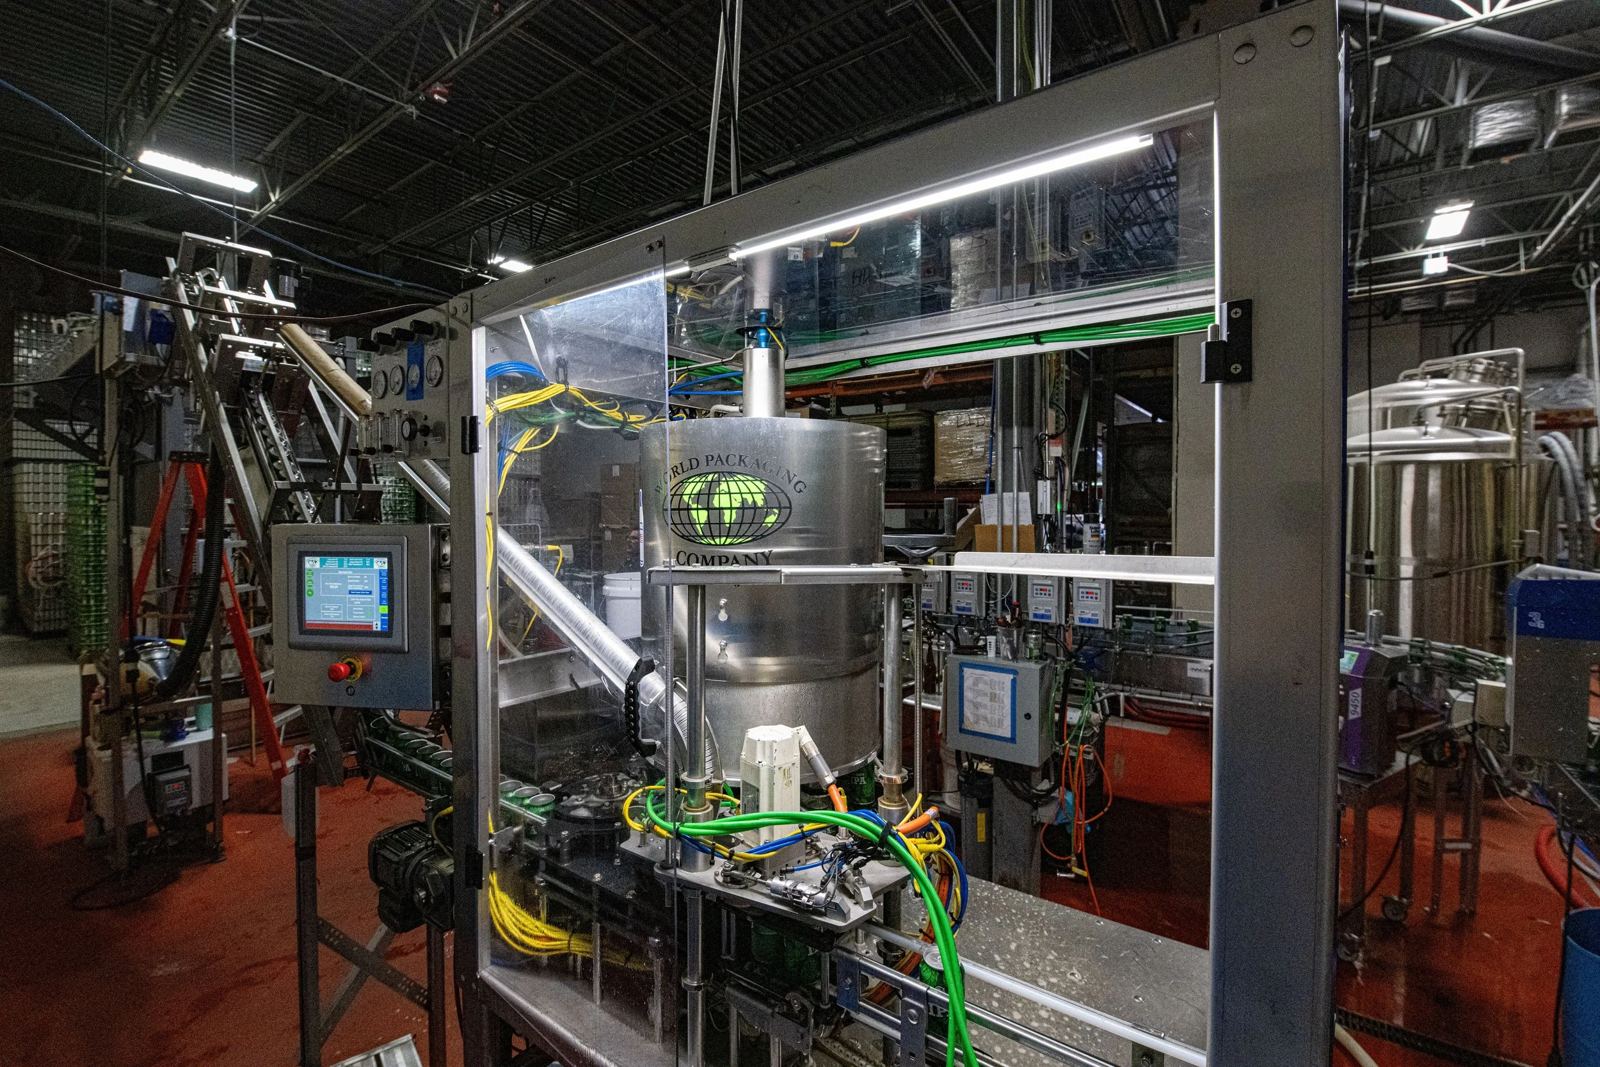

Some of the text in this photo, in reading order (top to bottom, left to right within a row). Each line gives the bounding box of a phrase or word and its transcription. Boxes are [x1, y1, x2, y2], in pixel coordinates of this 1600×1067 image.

[655, 452, 807, 494] WORLD PACKAGING
[676, 550, 773, 566] COMPANY
[928, 1001, 949, 1018] IP
